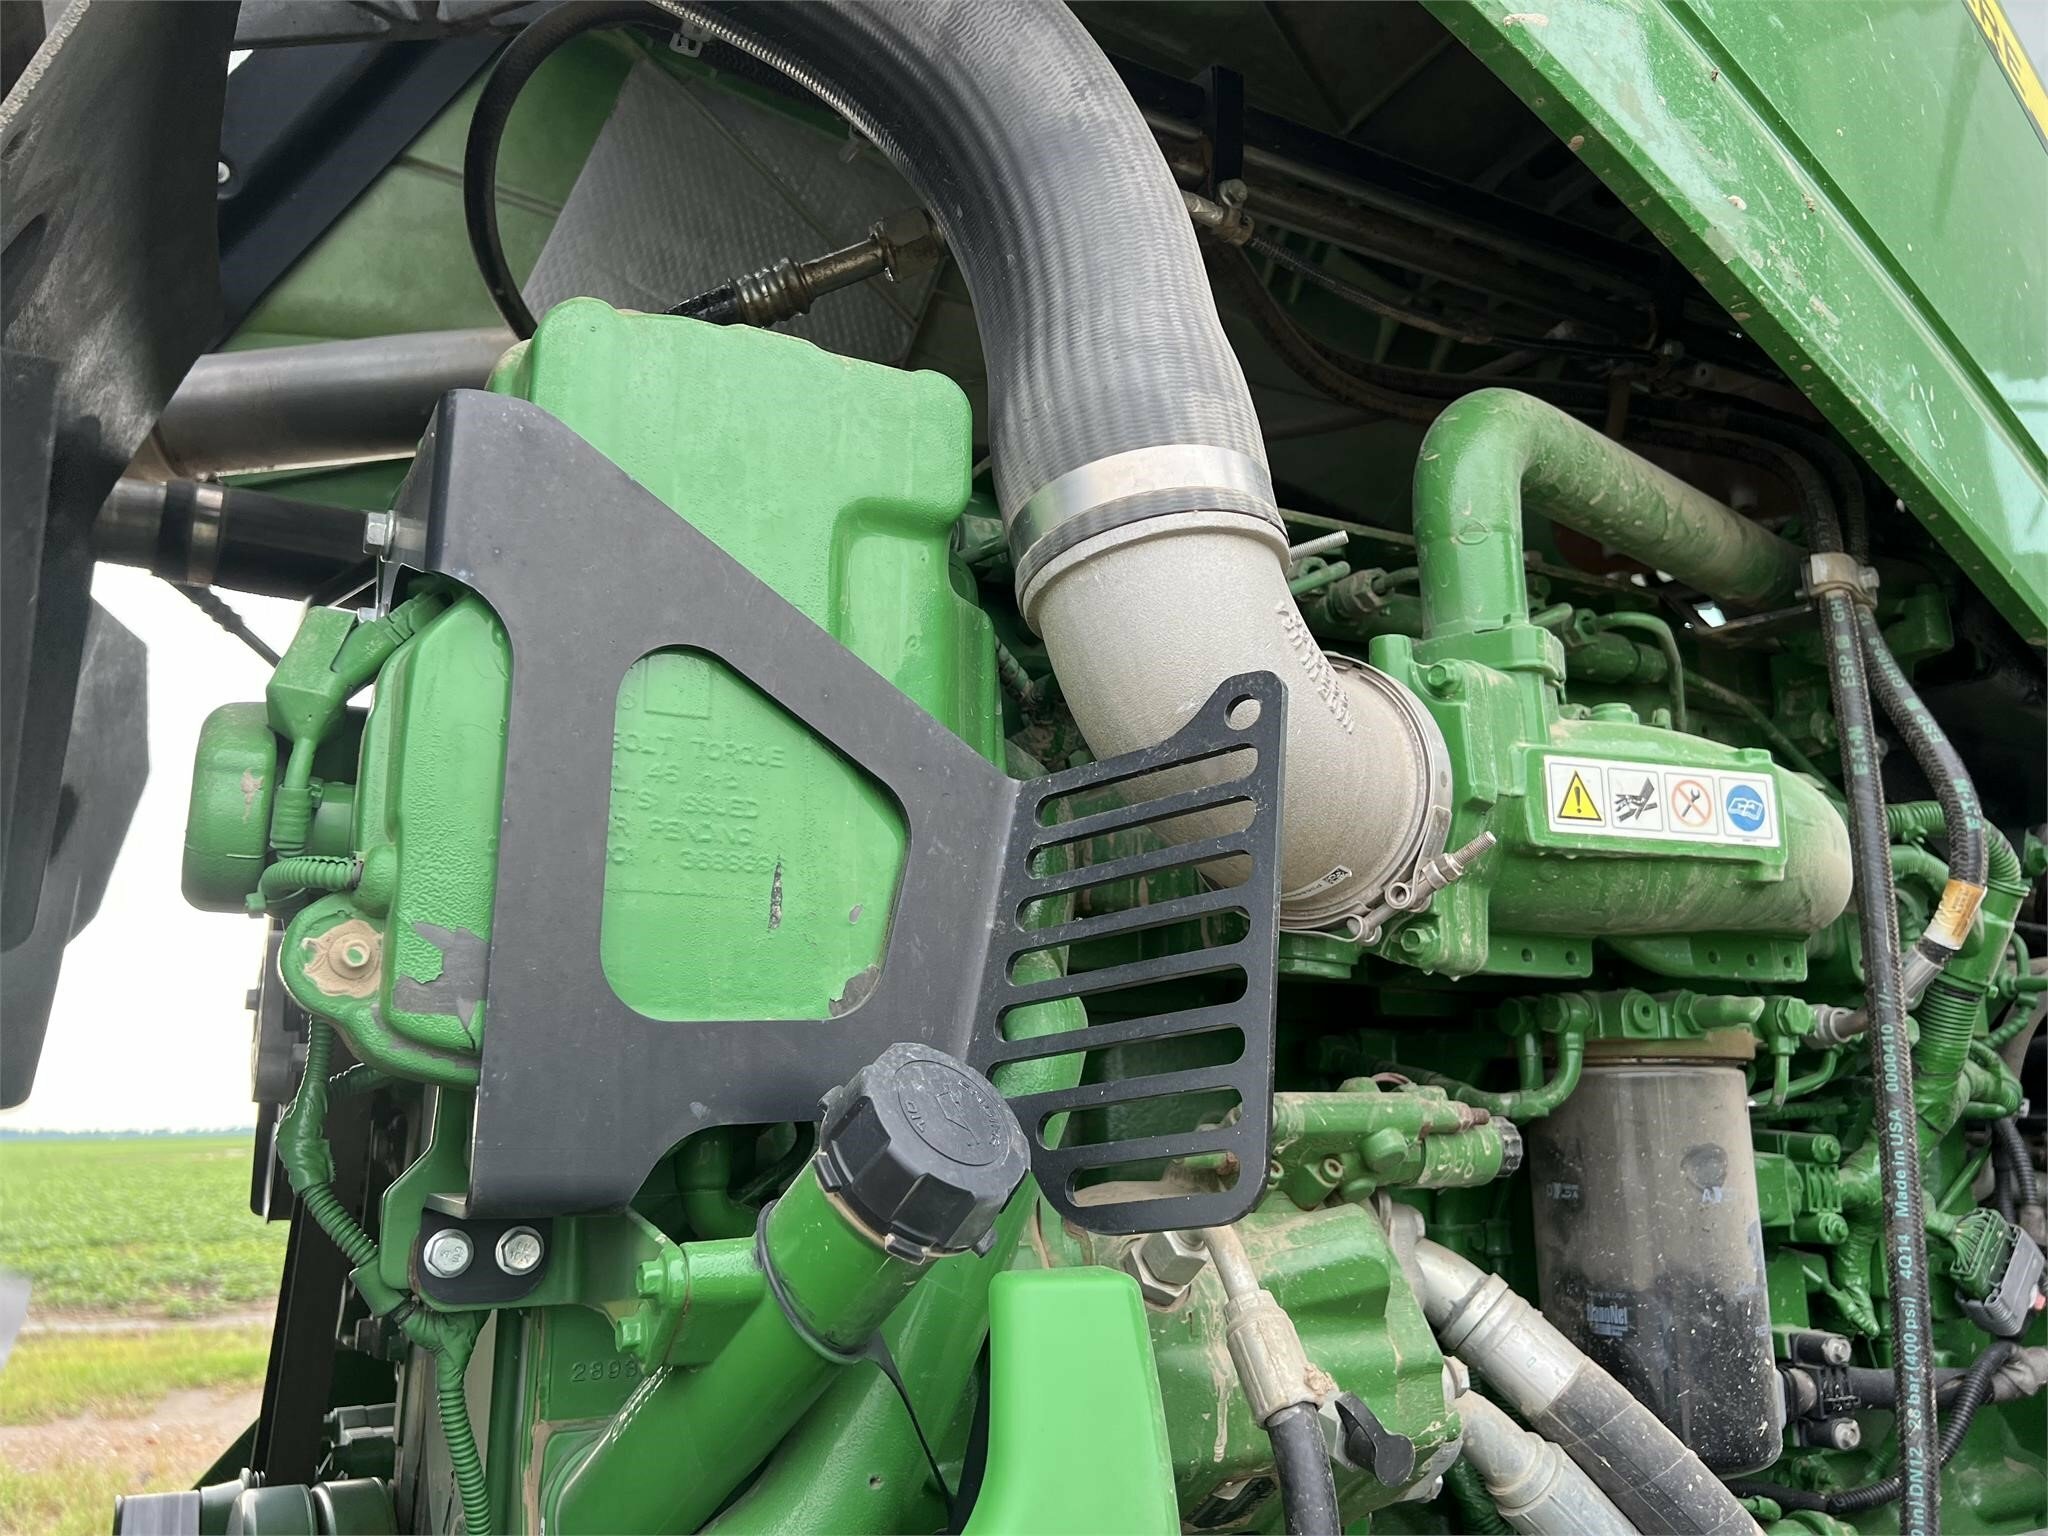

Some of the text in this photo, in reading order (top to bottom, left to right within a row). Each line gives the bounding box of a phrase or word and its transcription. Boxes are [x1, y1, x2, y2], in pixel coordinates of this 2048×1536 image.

[1839, 655, 1856, 688] ESP
[1917, 714, 1943, 744] ESP
[1880, 1023, 1899, 1092] 0000410
[1888, 1108, 1904, 1146] USA
[1891, 1150, 1905, 1166] in
[1893, 1171, 1909, 1217] Made
[1900, 1297, 1919, 1329] psi)
[1907, 1375, 1923, 1404] bar
[1909, 1447, 1924, 1497] DN12
